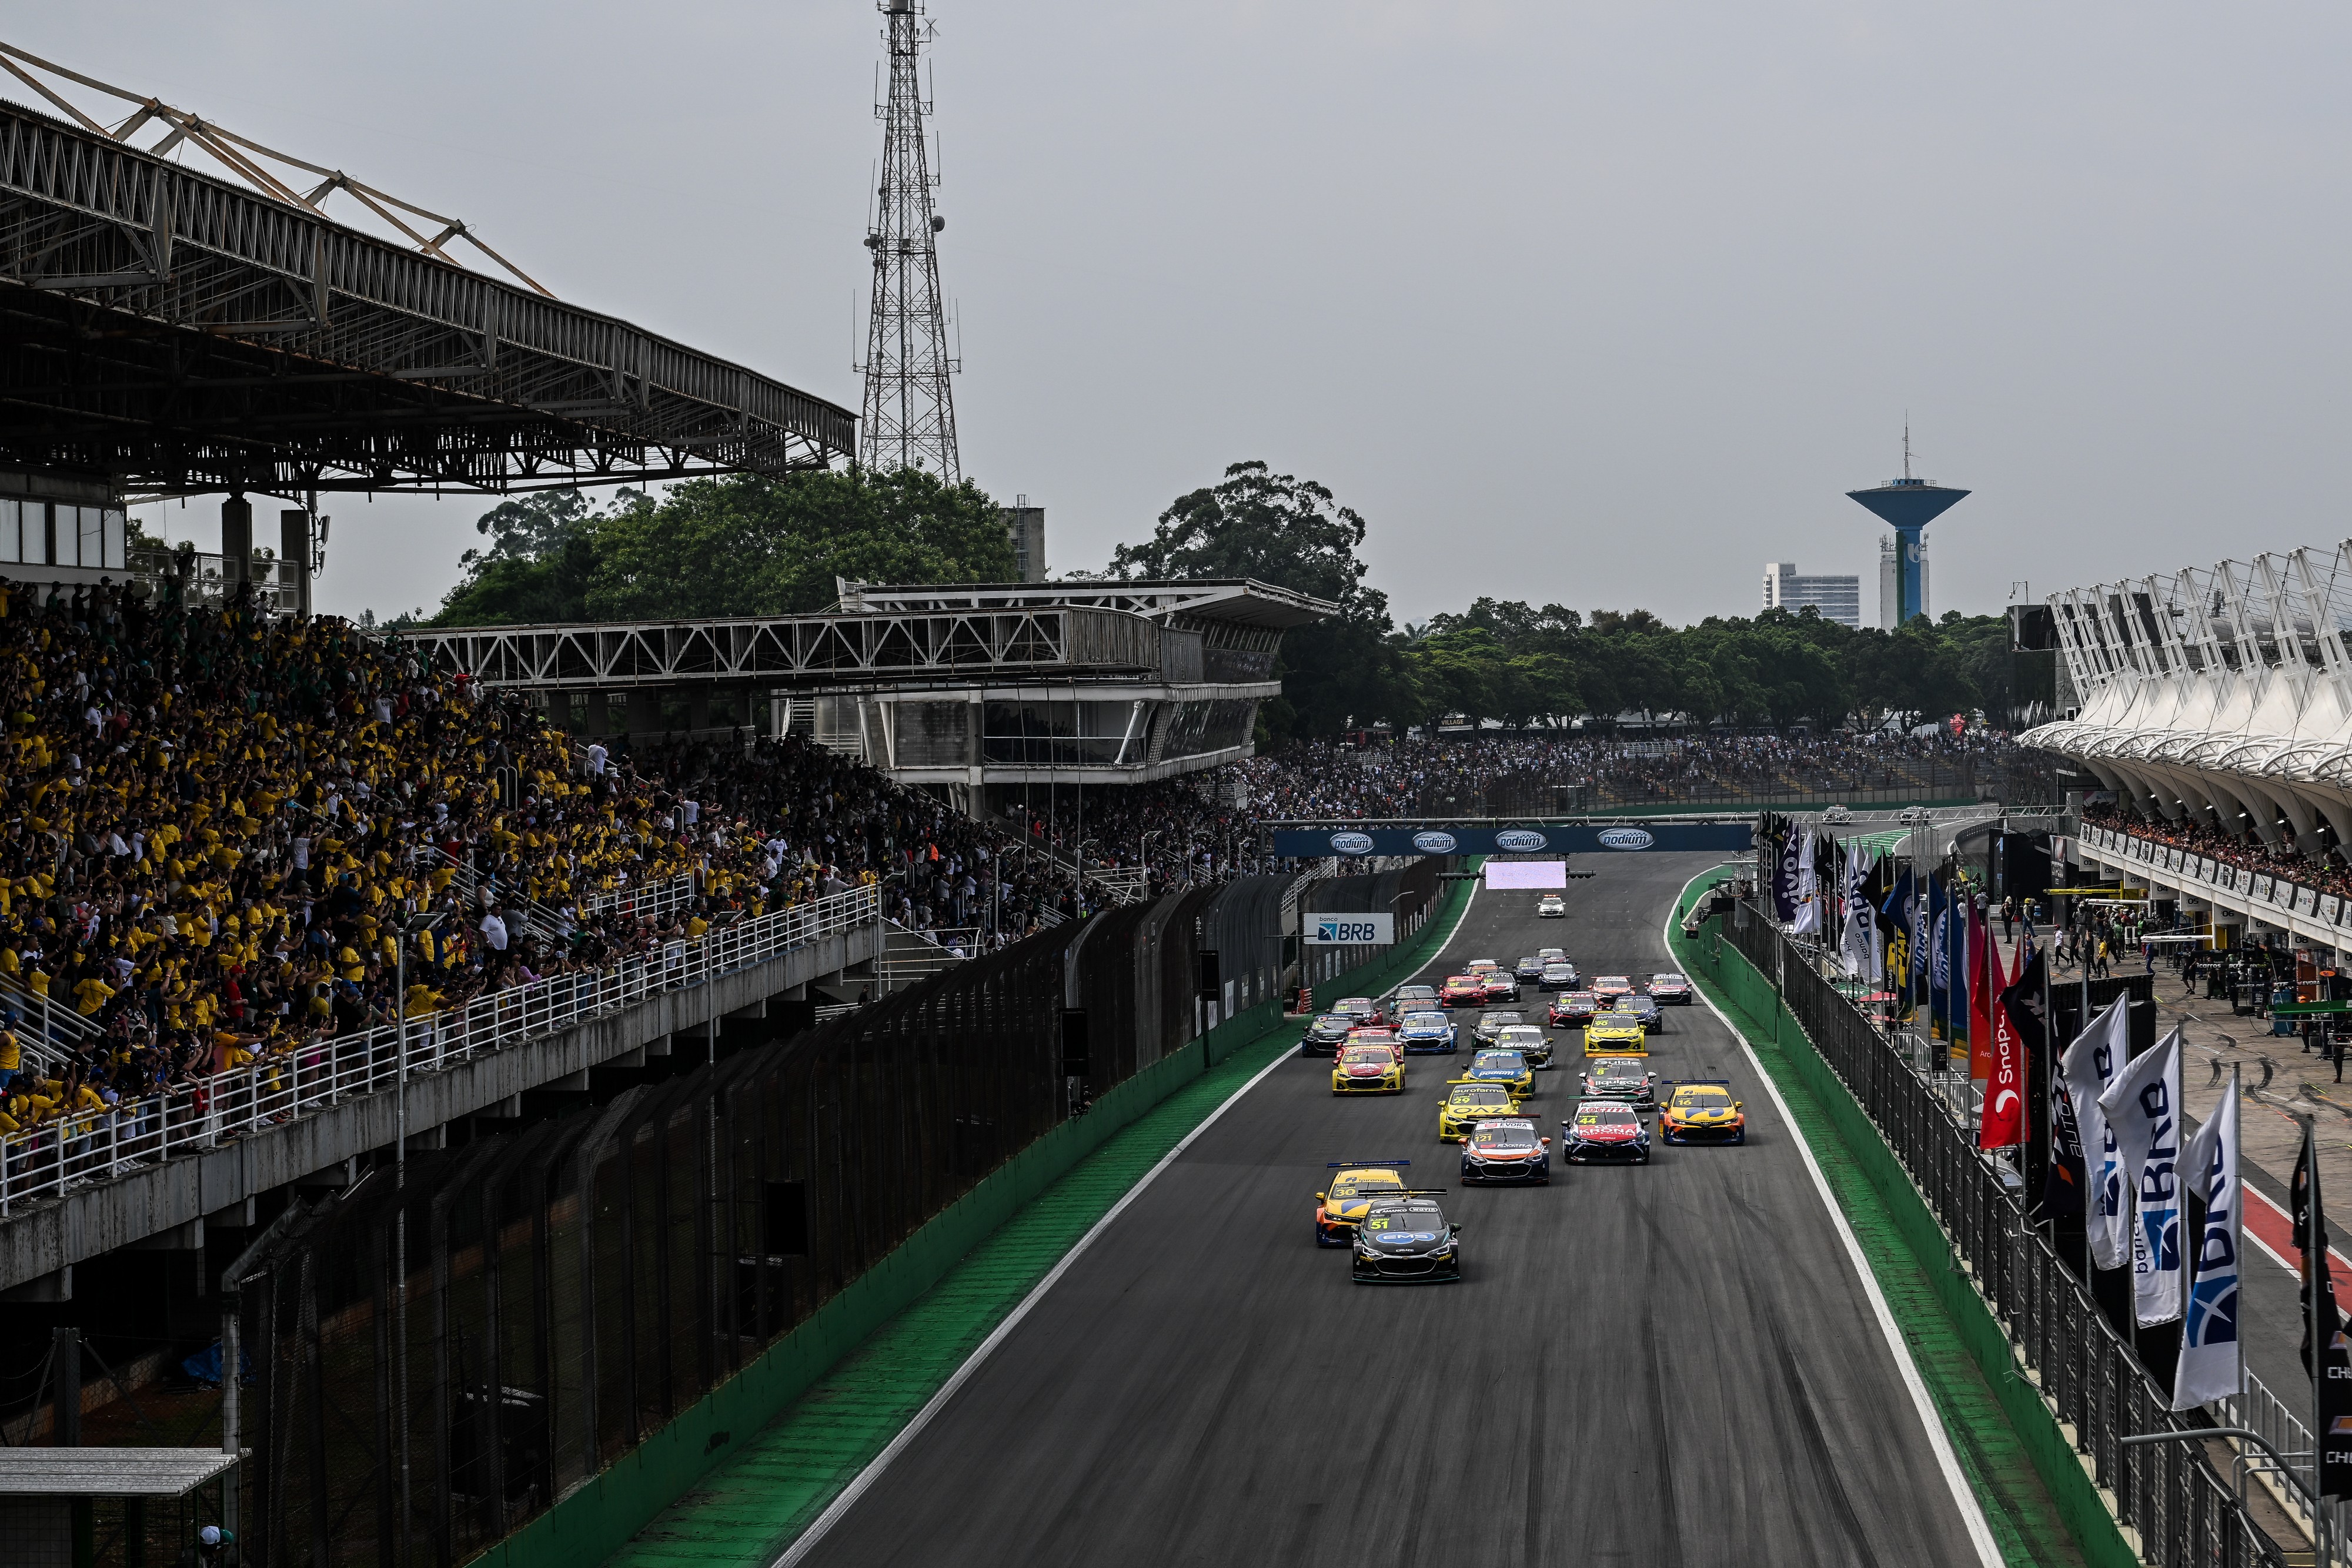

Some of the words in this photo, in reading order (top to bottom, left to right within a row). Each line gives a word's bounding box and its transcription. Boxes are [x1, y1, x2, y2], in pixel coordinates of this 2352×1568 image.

[1335, 839, 1368, 848] podium
[1417, 838, 1451, 848] podium
[1501, 837, 1541, 847] podium
[1603, 834, 1647, 845] podium
[1338, 923, 1375, 941] BRB
[1855, 933, 1869, 959] banco
[1475, 1134, 1492, 1143] 121
[1335, 1188, 1357, 1197] 30
[1370, 1220, 1389, 1230] 51
